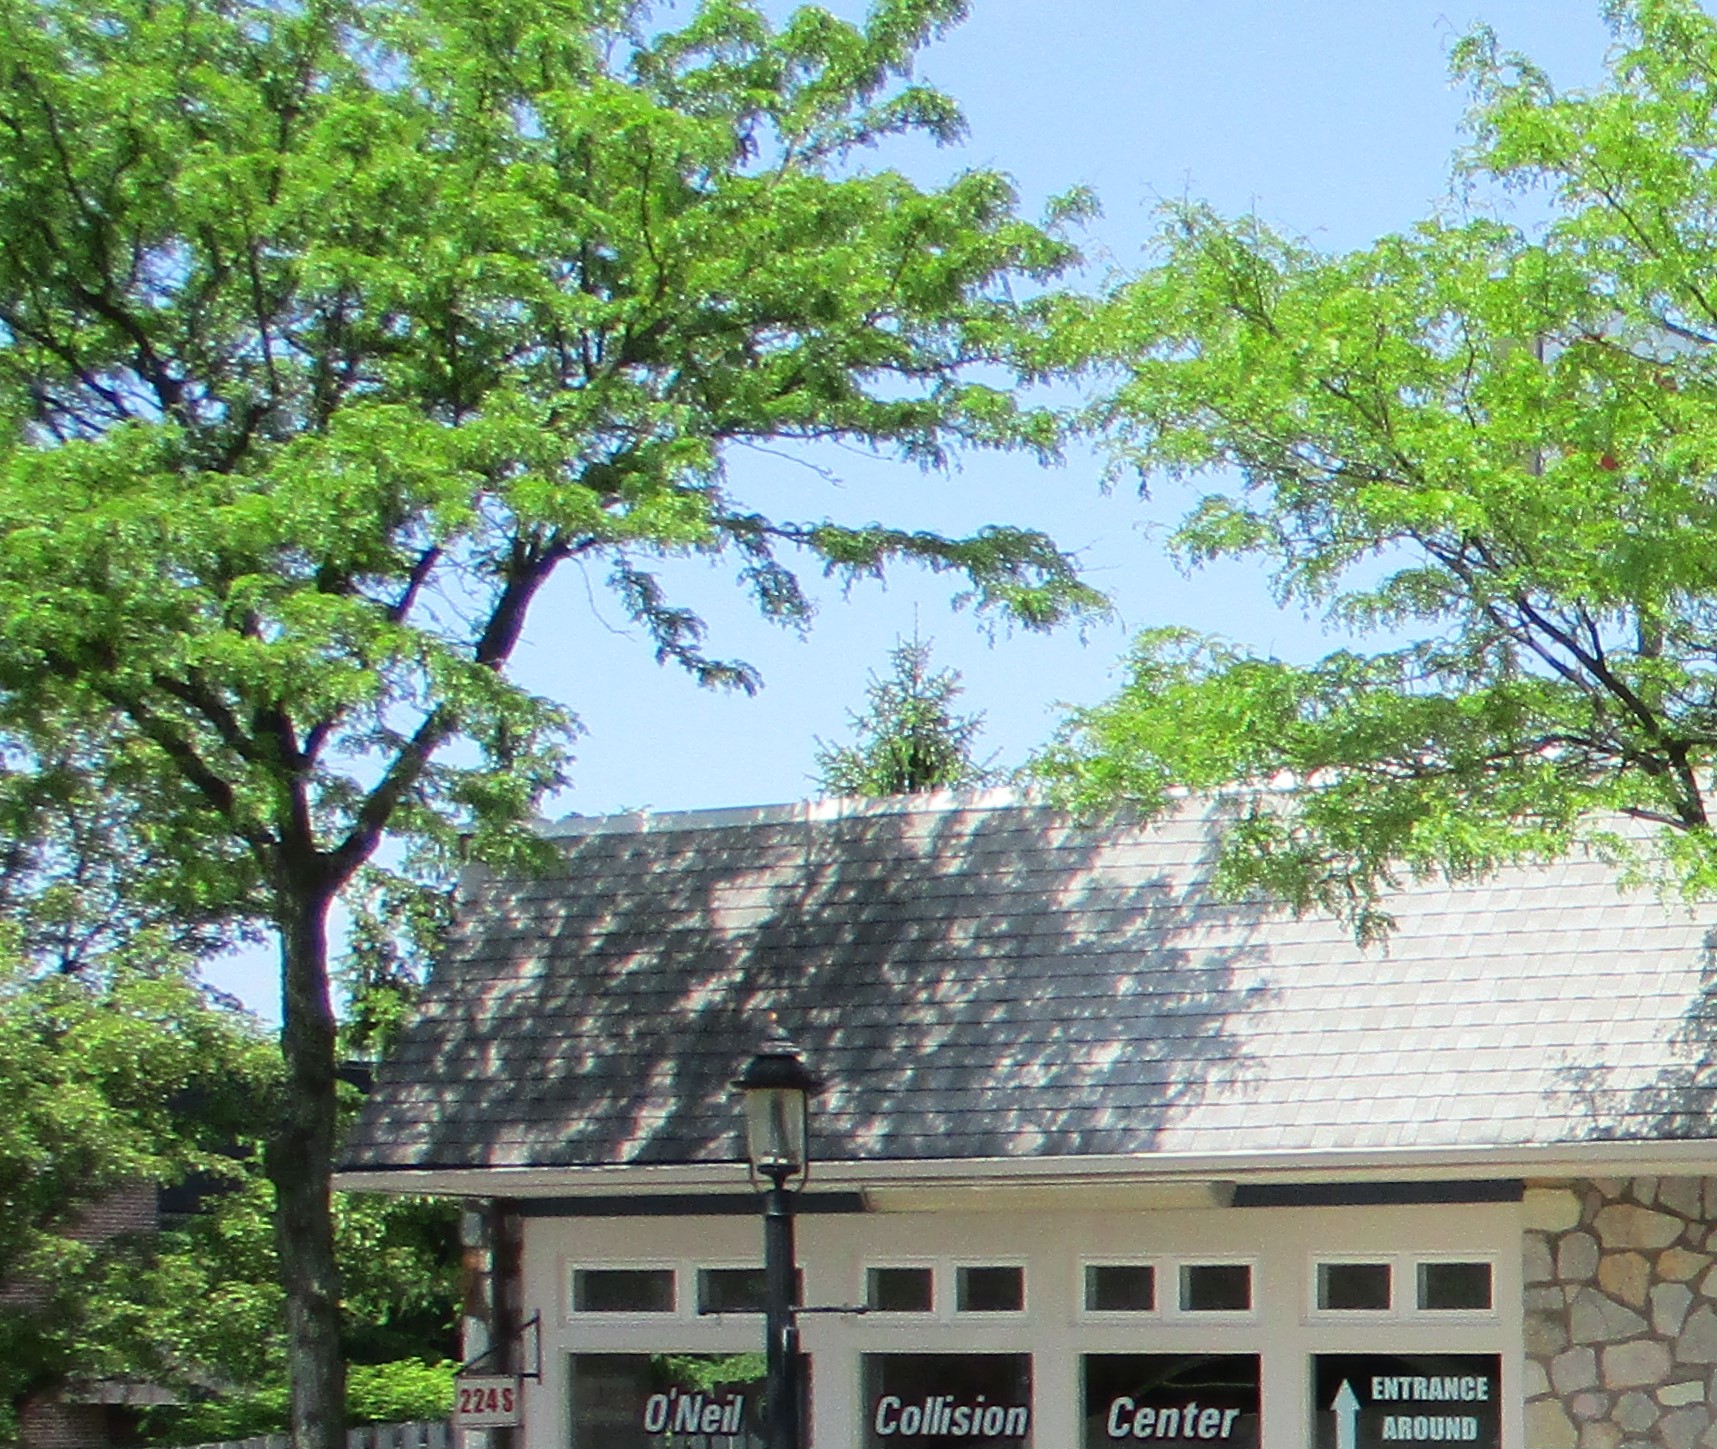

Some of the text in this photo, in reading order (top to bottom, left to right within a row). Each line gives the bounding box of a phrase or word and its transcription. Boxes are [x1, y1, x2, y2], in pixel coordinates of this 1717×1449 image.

[1371, 1376, 1489, 1401] ENTRANCE
[644, 1387, 1240, 1439] O'Neil Collision Center
[1382, 1416, 1478, 1441] AROUND
